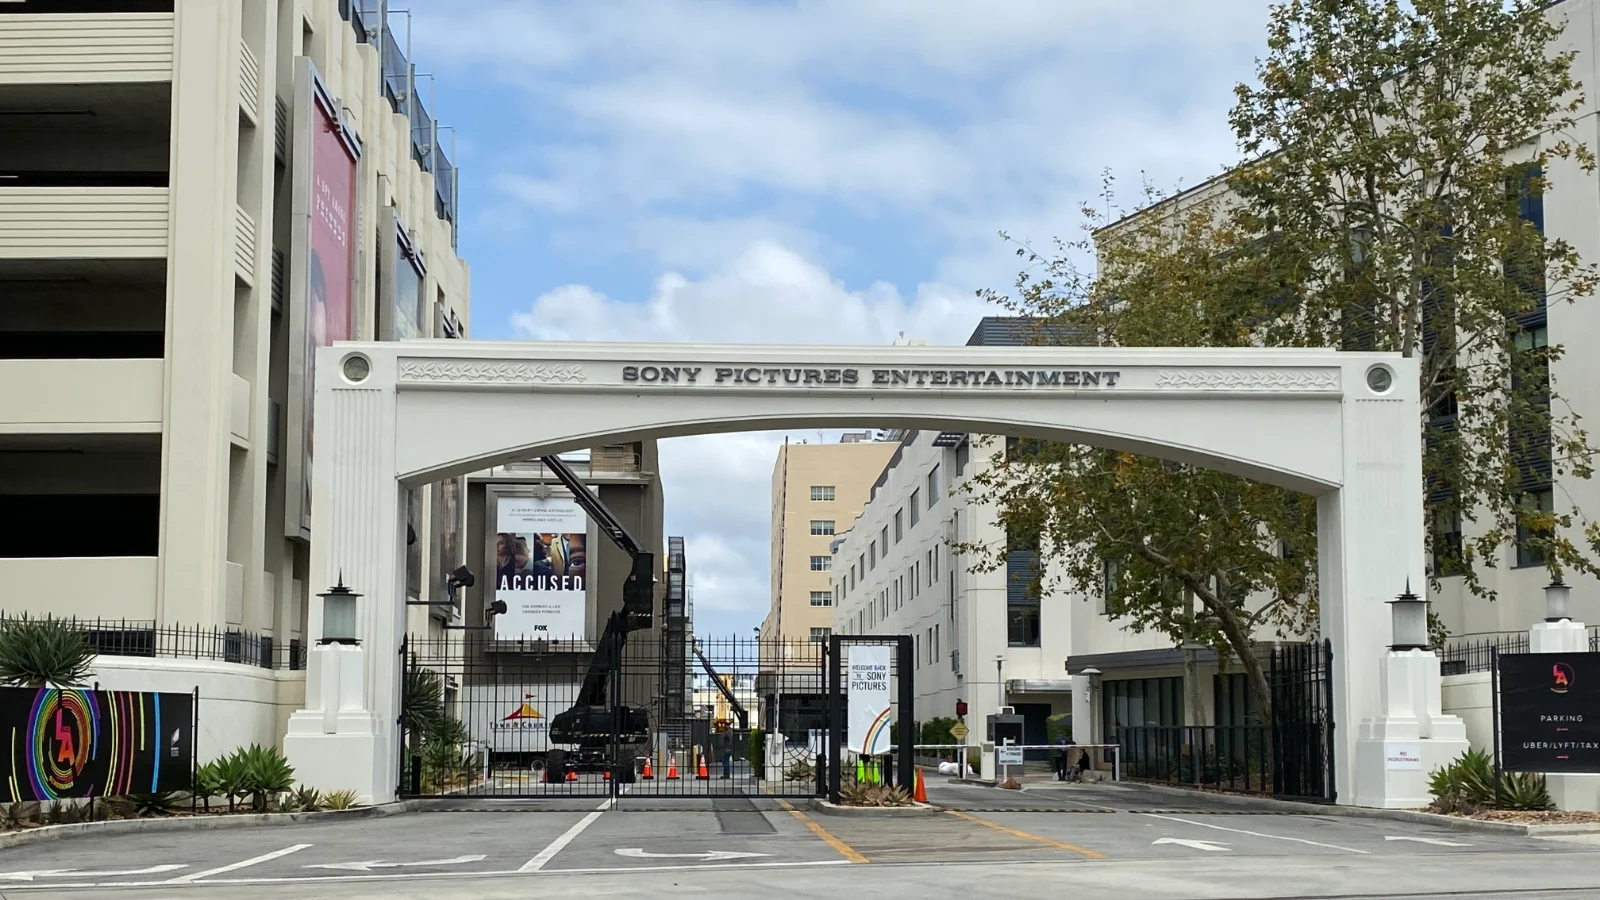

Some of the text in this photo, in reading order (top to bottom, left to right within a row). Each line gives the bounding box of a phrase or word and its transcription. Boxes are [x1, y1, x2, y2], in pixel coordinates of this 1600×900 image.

[622, 366, 1120, 386] SONY PICTURES ENTERTAINMENT
[500, 575, 582, 591] ACCUSED
[867, 672, 886, 680] SONY
[852, 682, 886, 690] PICTURES
[1540, 714, 1583, 722] PARKING
